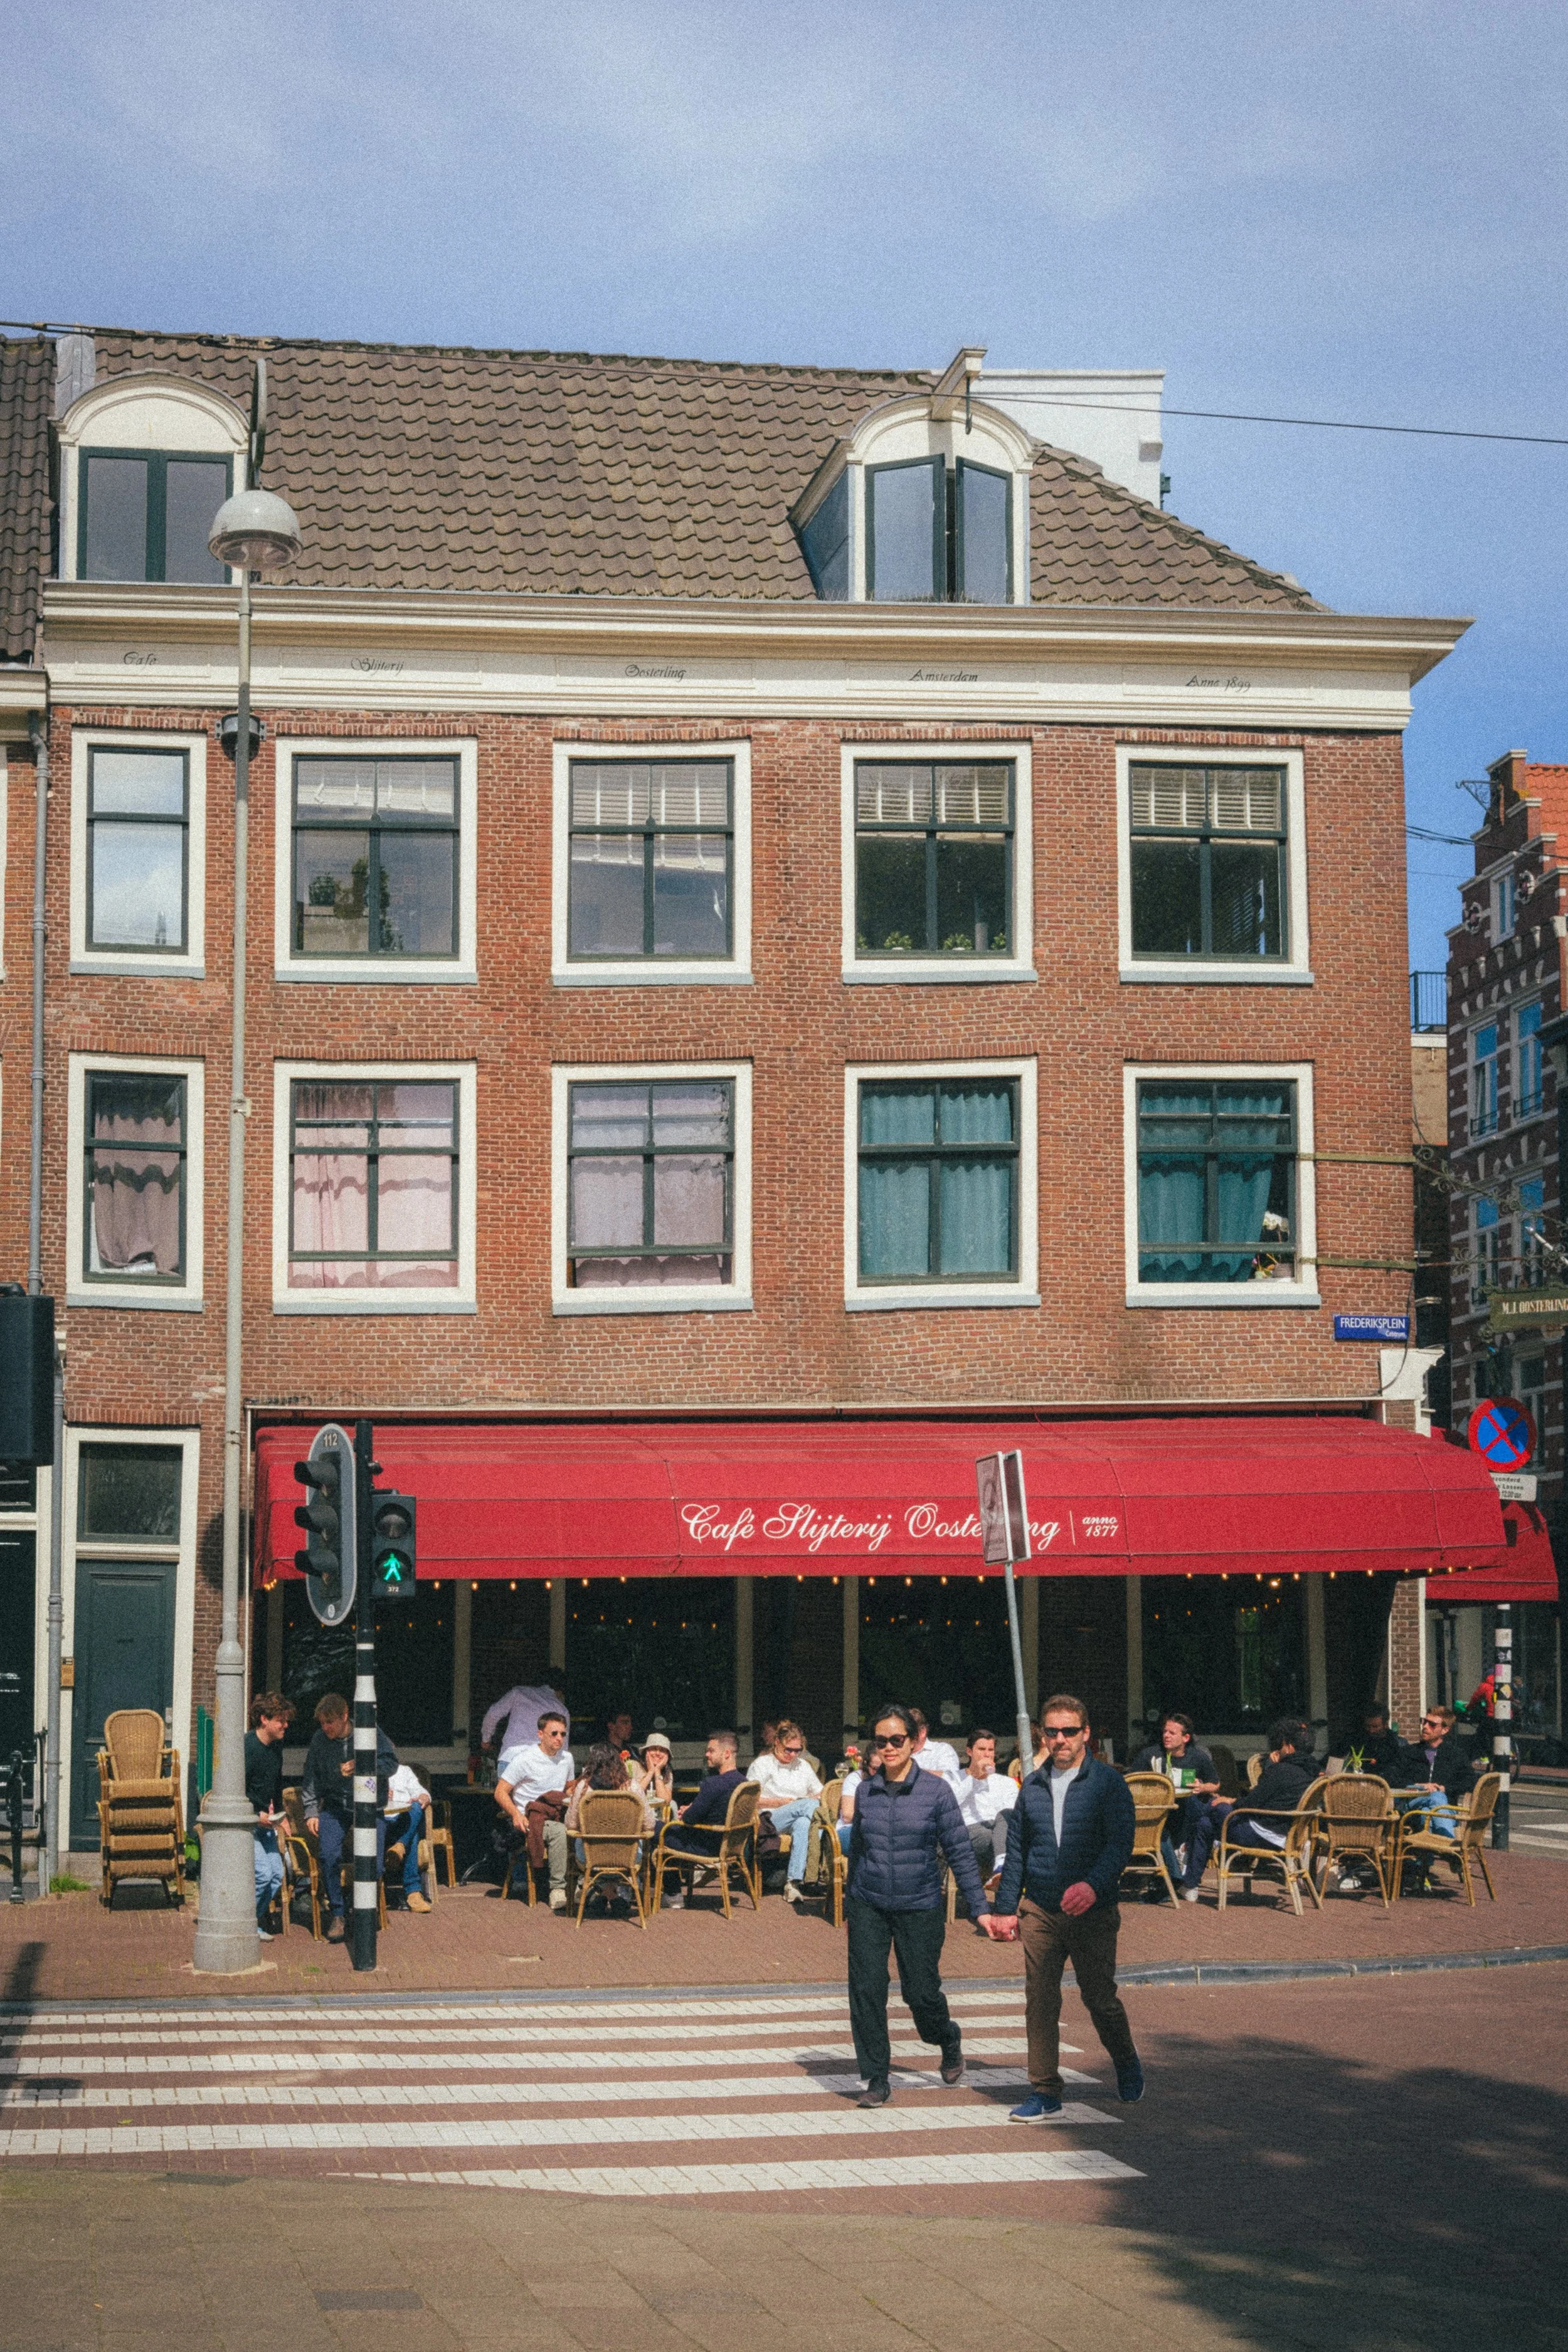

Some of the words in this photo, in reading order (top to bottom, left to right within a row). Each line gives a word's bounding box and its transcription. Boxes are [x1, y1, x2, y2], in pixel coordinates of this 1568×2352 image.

[351, 657, 405, 676] Slijterij
[625, 664, 687, 683] Oosterling
[908, 669, 978, 682] Amsterdam
[1185, 675, 1219, 687] Anno
[1224, 677, 1251, 693] 1899
[1340, 1316, 1406, 1329] FREDERIKSPLEIN
[324, 1433, 337, 1447] 112
[1082, 1515, 1118, 1525] anno
[681, 1503, 755, 1551] Café
[763, 1502, 892, 1552] Slijterij
[904, 1502, 1061, 1551] Oosteng
[1084, 1525, 1118, 1537] 1877
